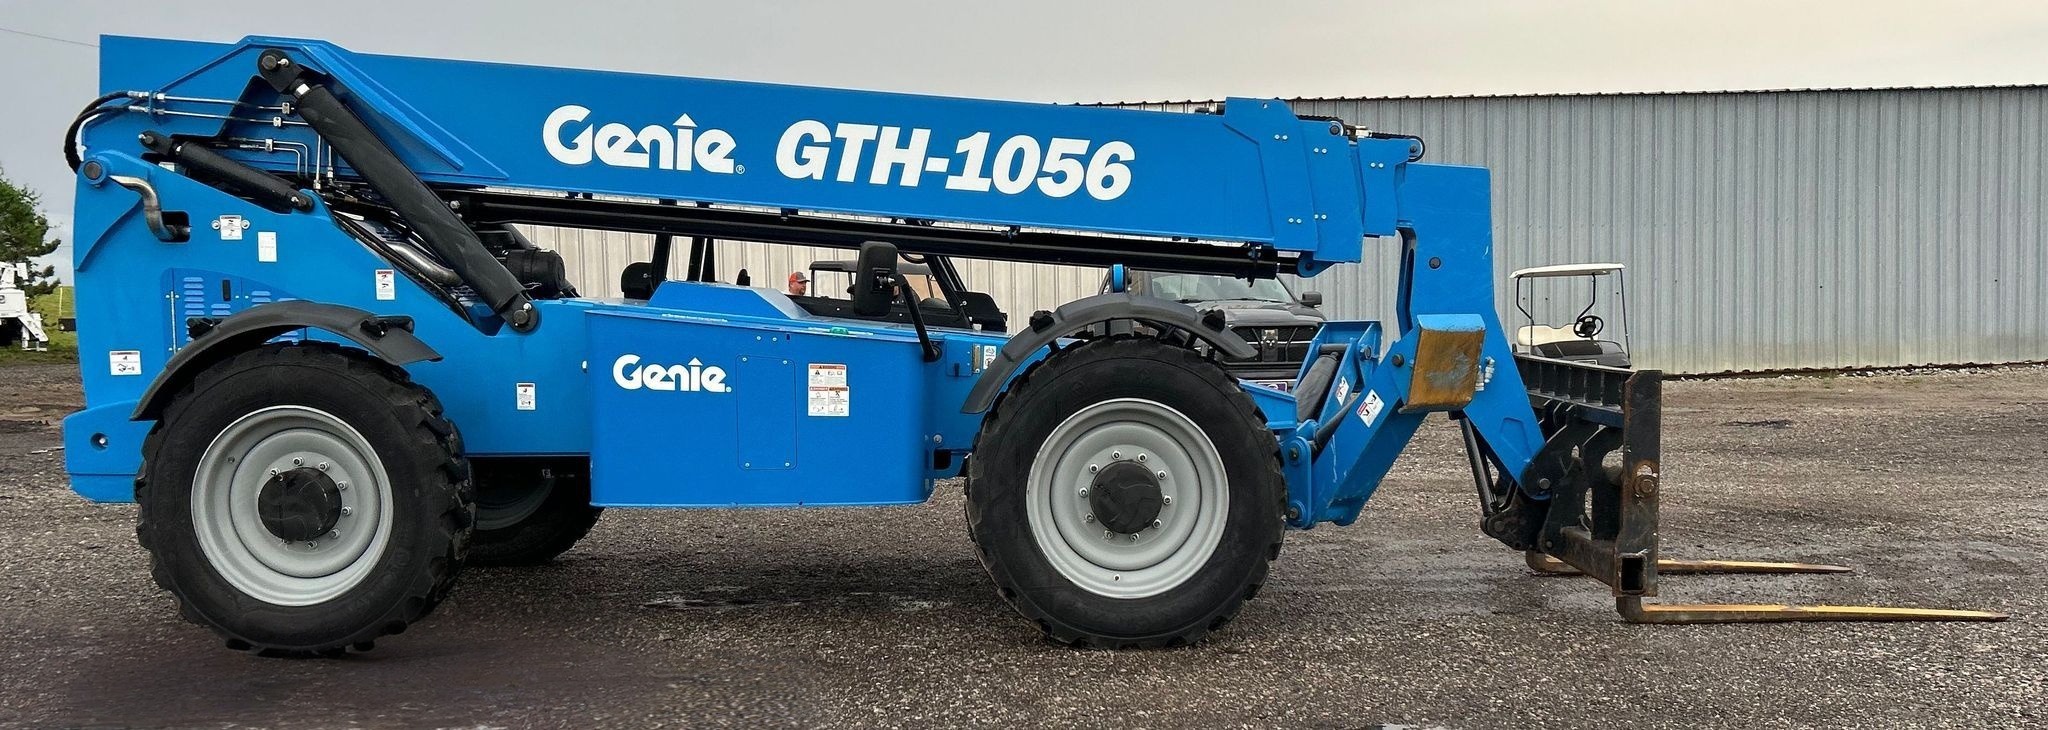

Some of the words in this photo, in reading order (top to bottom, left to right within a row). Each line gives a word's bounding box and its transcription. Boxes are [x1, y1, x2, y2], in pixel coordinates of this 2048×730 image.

[542, 104, 736, 174] Genie
[775, 119, 1136, 201] GTH-1056
[612, 353, 727, 393] Genie
